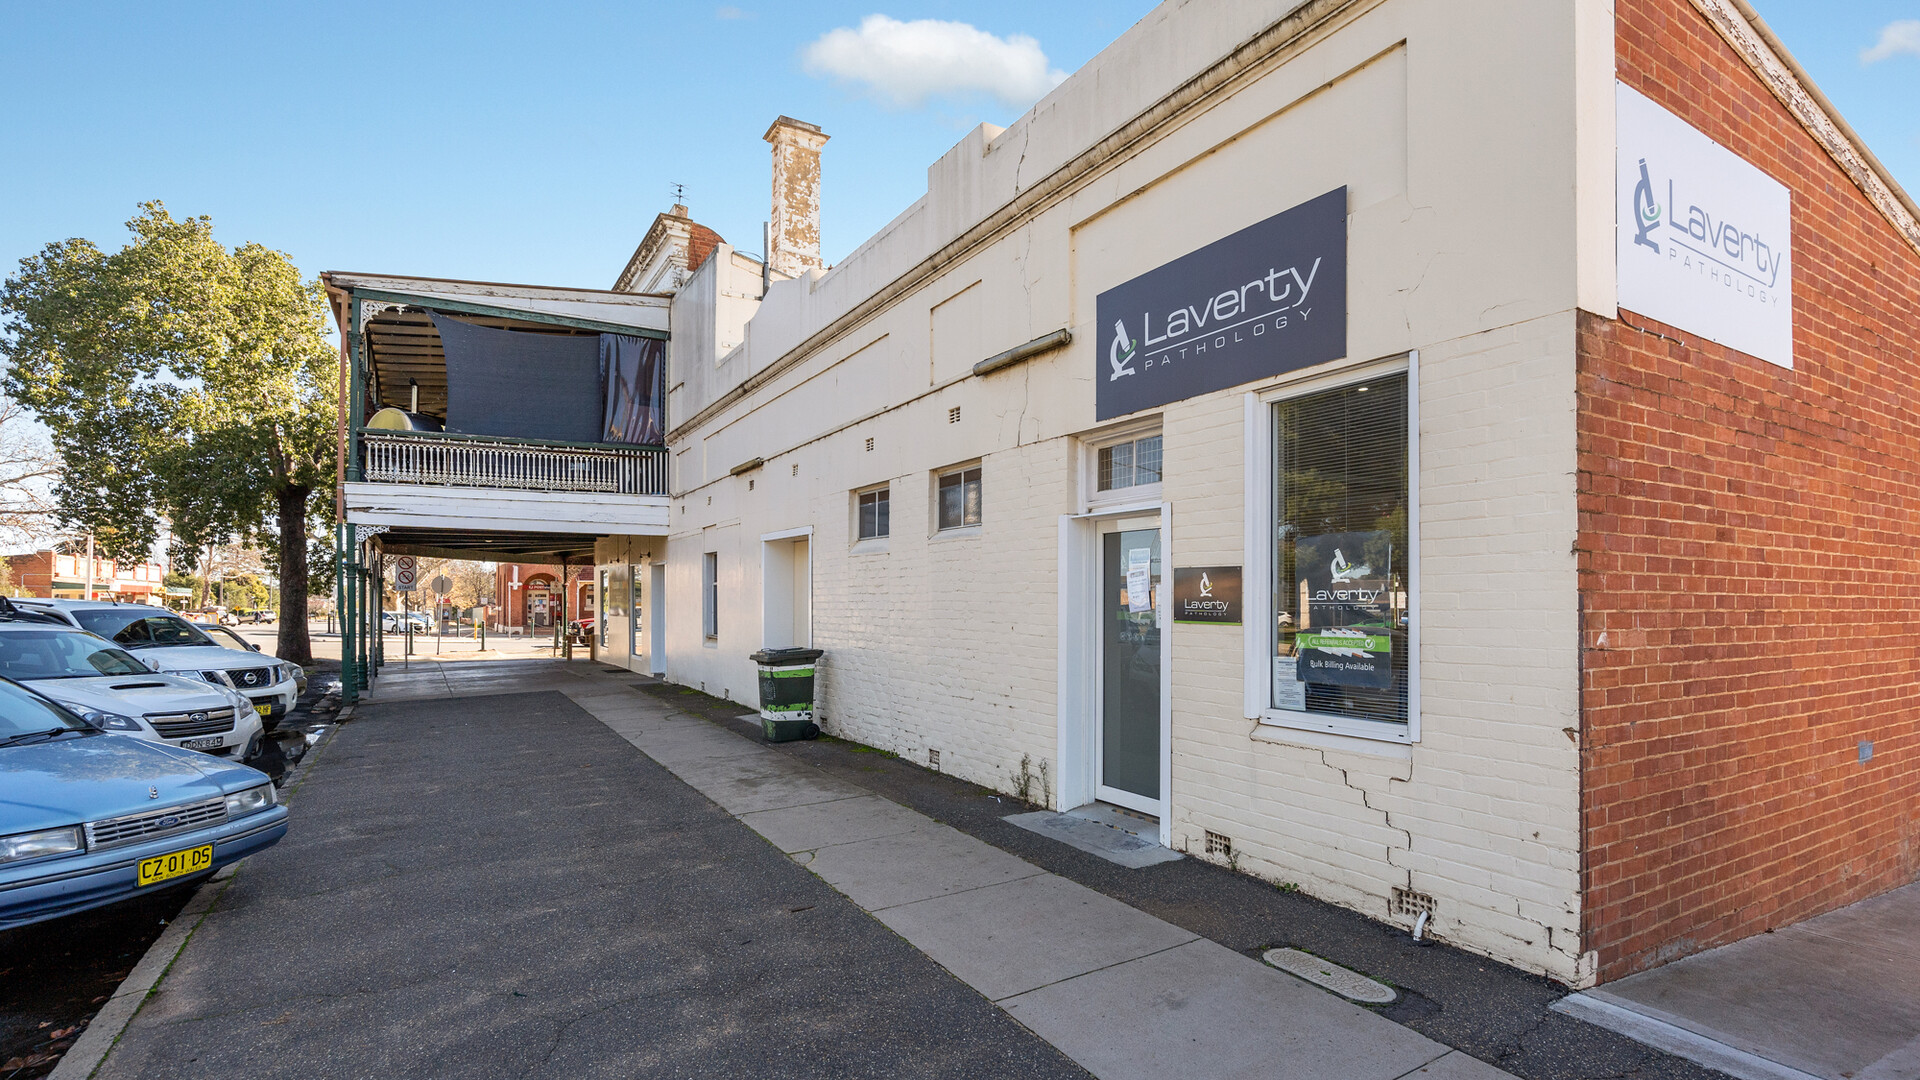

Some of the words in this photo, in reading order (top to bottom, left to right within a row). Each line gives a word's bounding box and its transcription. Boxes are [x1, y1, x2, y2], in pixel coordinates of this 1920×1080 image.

[1669, 179, 1781, 288] Laverty
[1144, 257, 1322, 347] Laverty
[1669, 248, 1778, 307] PATHOLOGY
[1144, 308, 1312, 371] PATHOLOGY
[1184, 598, 1229, 612] Laverty
[1305, 587, 1379, 604] Laverty
[1309, 660, 1324, 668] Bulk
[1324, 661, 1344, 671] Billing
[1344, 662, 1375, 672] Available
